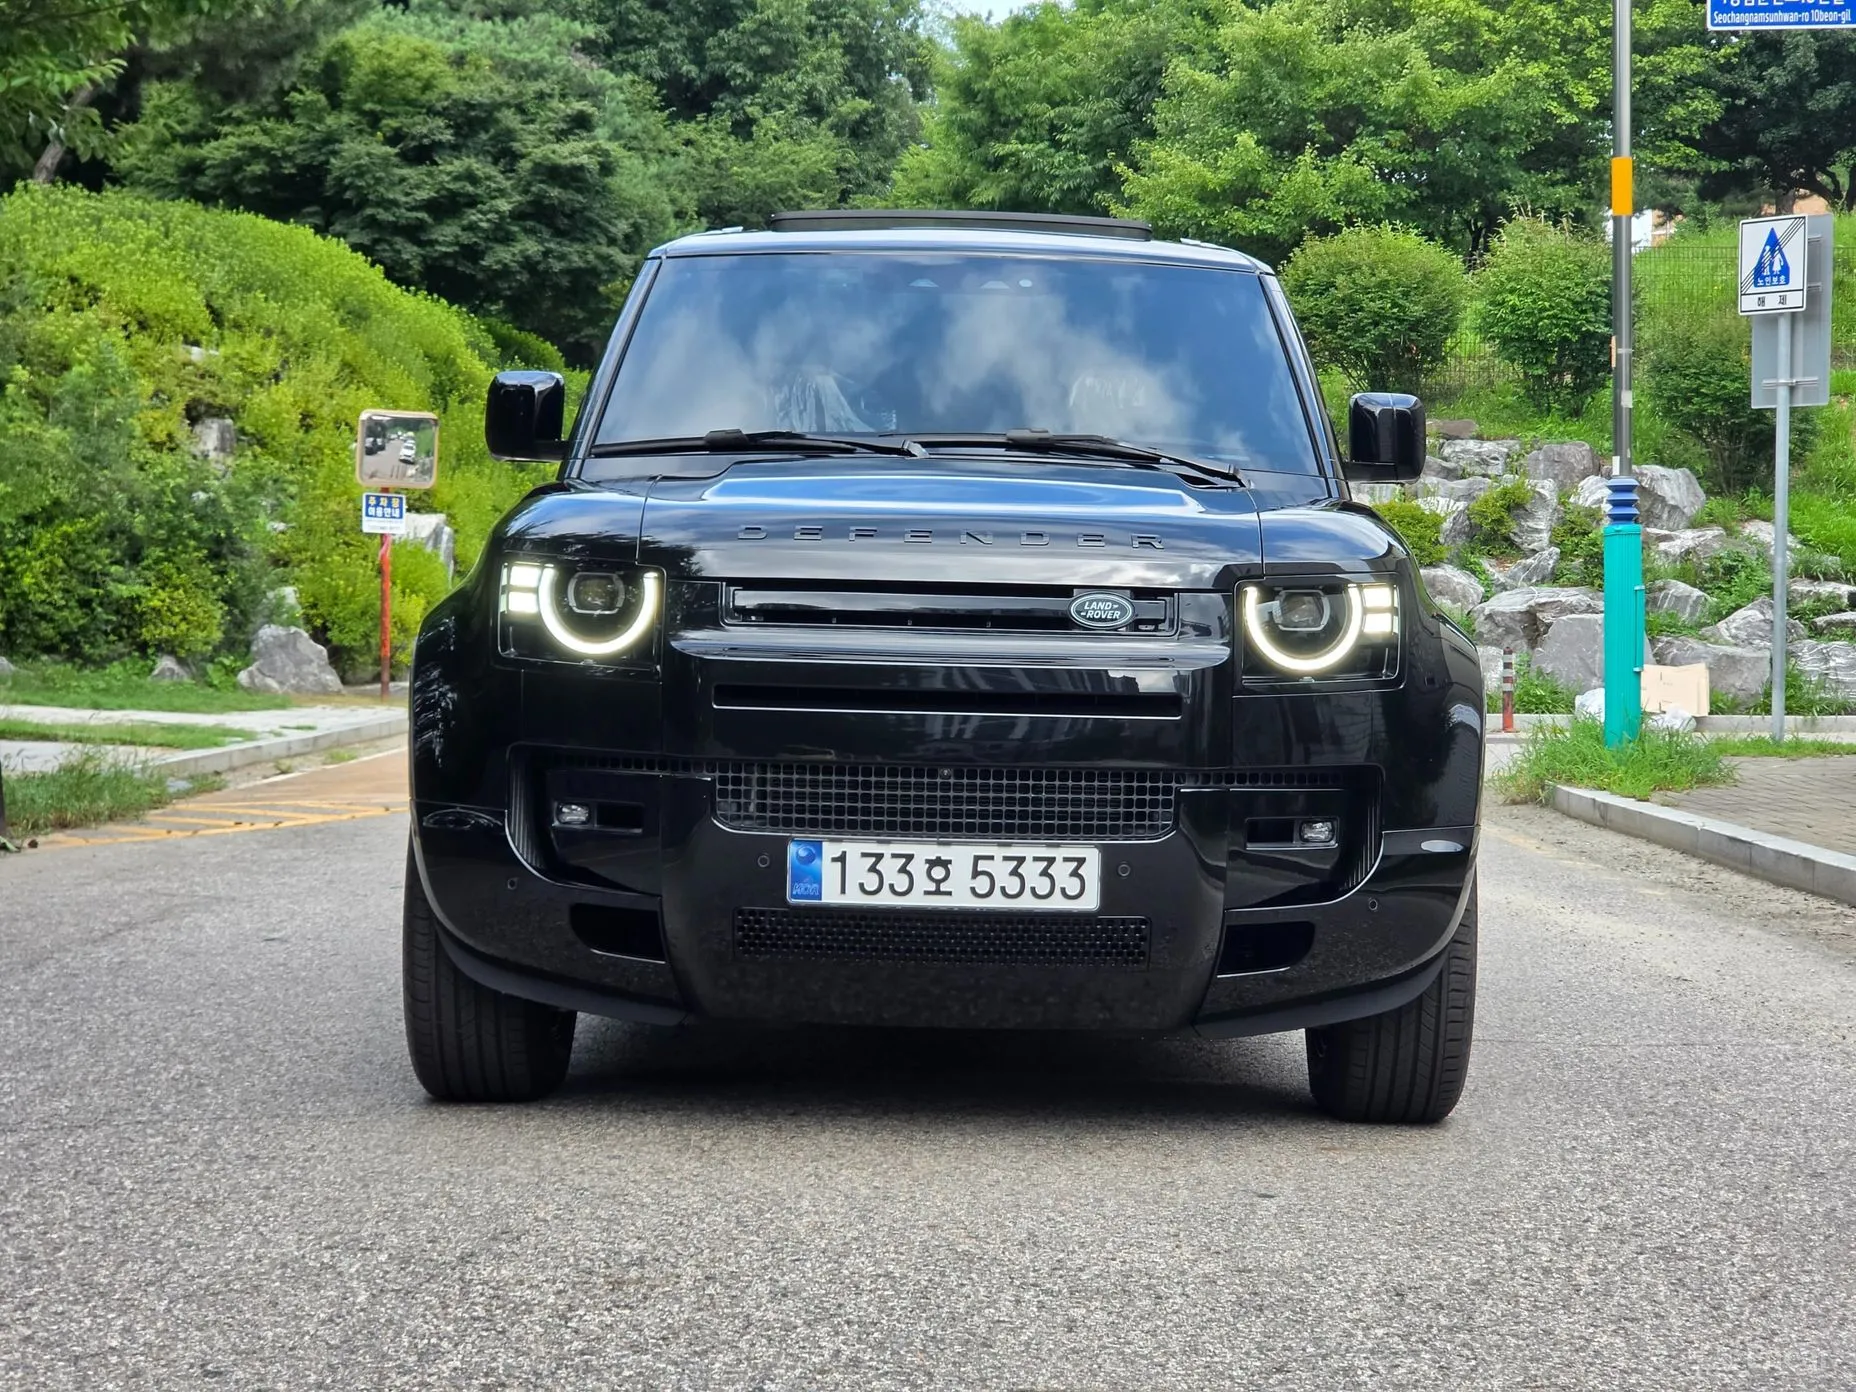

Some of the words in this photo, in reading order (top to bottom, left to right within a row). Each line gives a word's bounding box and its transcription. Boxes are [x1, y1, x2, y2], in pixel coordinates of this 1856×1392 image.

[1713, 10, 1810, 25] Seochangnamsunhwan-ro
[1810, 8, 1852, 24] 10beon-gil
[1757, 275, 1786, 286] 노인보호
[737, 525, 1165, 550] DEFENDER
[830, 850, 953, 896] 133호
[969, 854, 1087, 900] 5333
